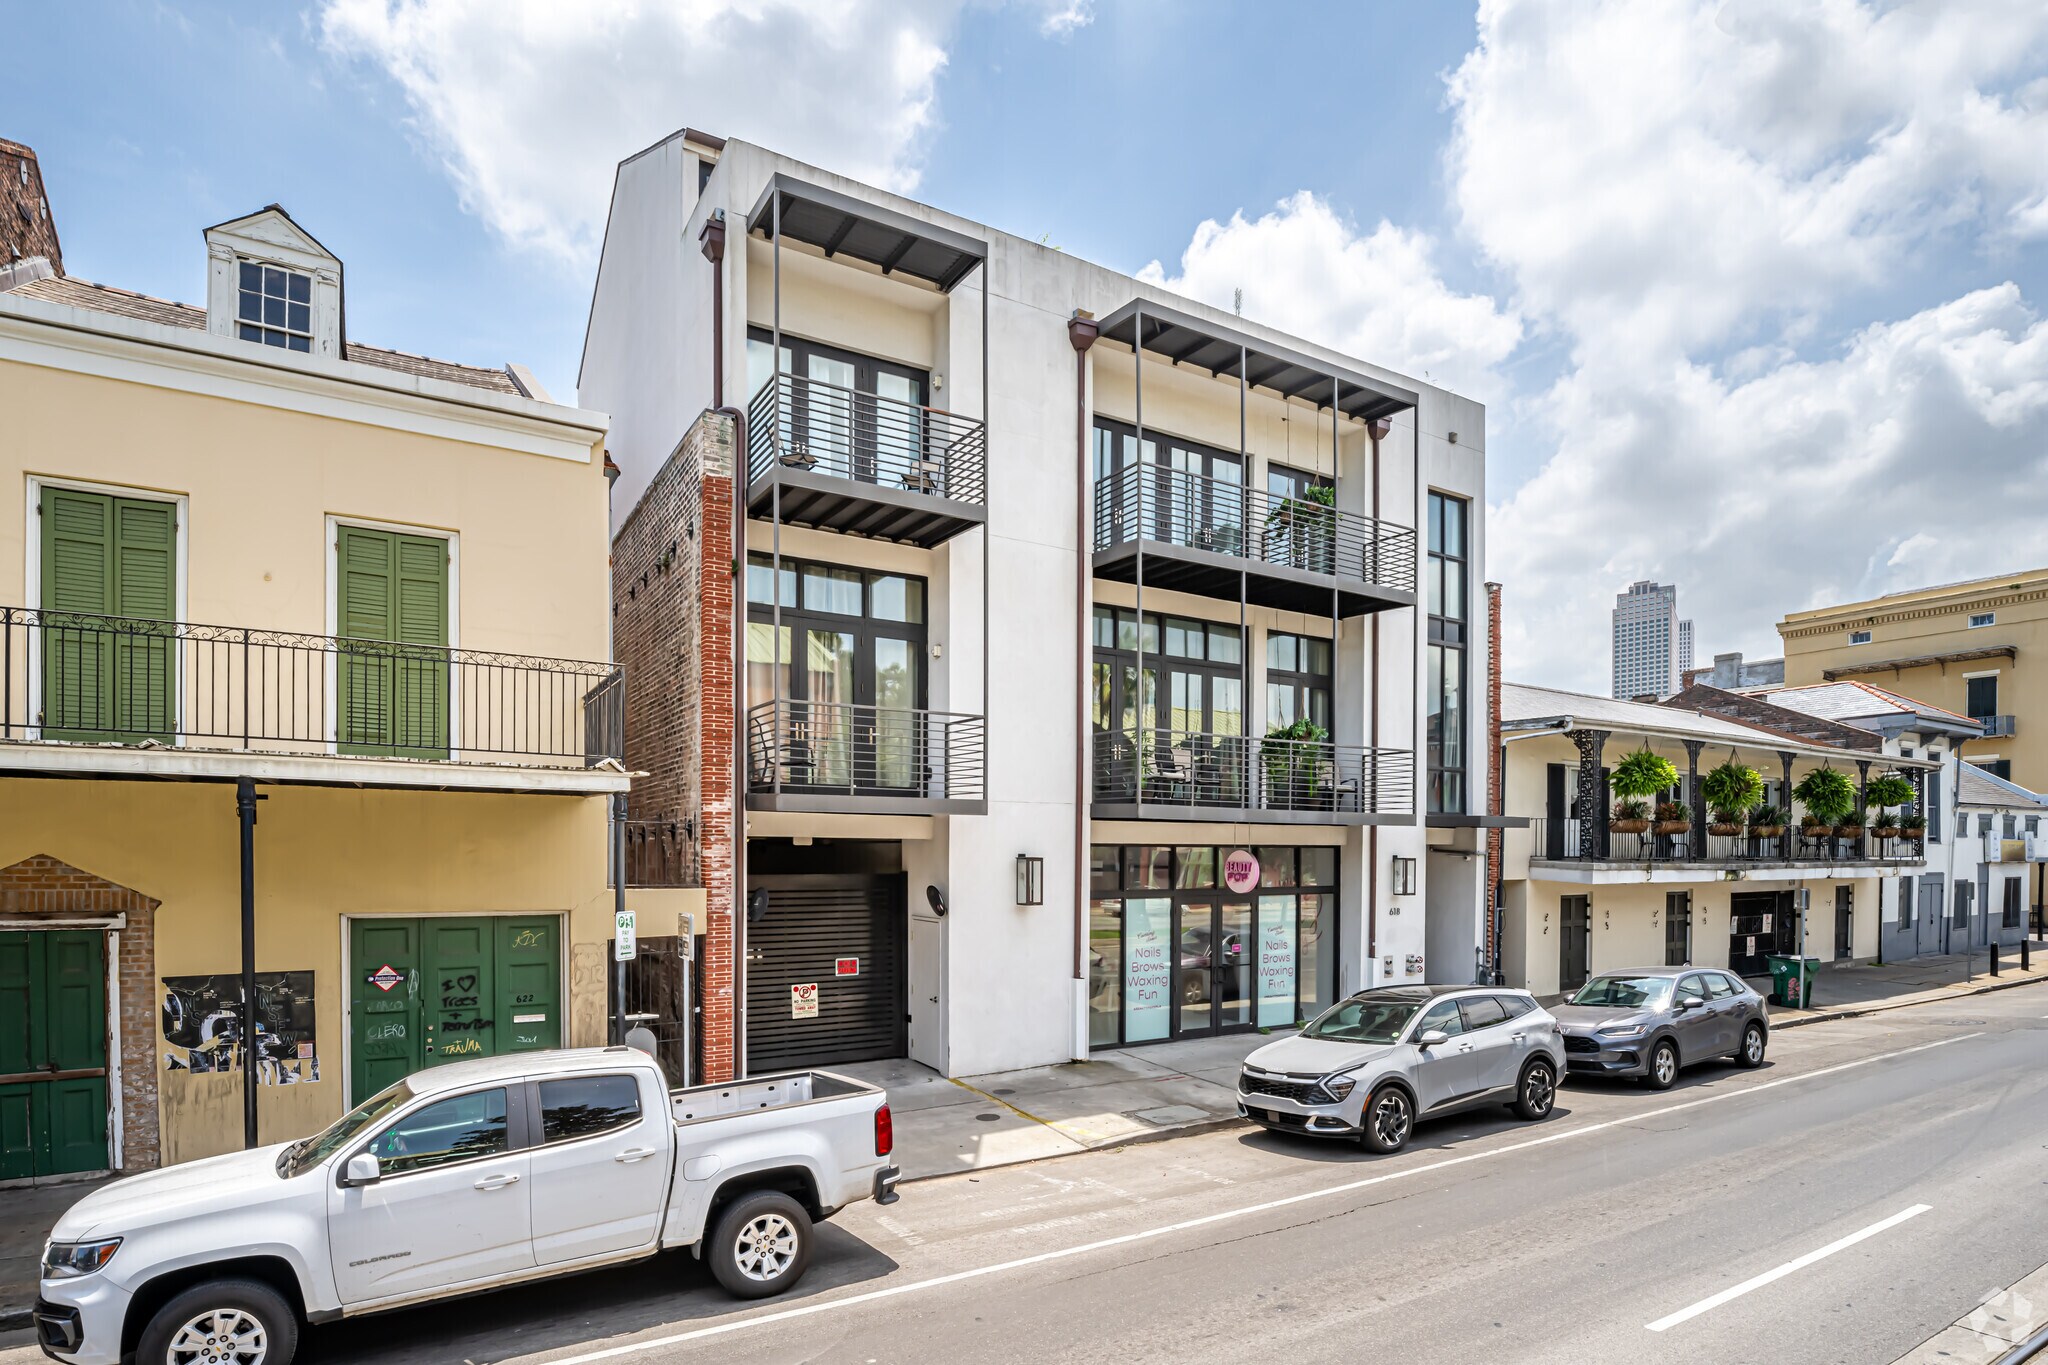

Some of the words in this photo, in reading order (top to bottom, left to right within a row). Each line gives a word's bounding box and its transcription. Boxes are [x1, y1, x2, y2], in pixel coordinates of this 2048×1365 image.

[1226, 861, 1252, 873] BEAUTY
[1227, 872, 1250, 882] POP
[1389, 907, 1401, 916] 618
[1265, 940, 1288, 951] Nails
[1135, 946, 1161, 958] Nails
[1262, 953, 1291, 964] Brows
[1131, 961, 1165, 973] Brows
[1259, 965, 1294, 977] Waxing
[1127, 974, 1168, 987] Waxing
[1268, 979, 1285, 989] Fun
[516, 994, 534, 1003] 622
[1138, 989, 1158, 1000] Fun
[349, 1251, 411, 1267] COLORADO
